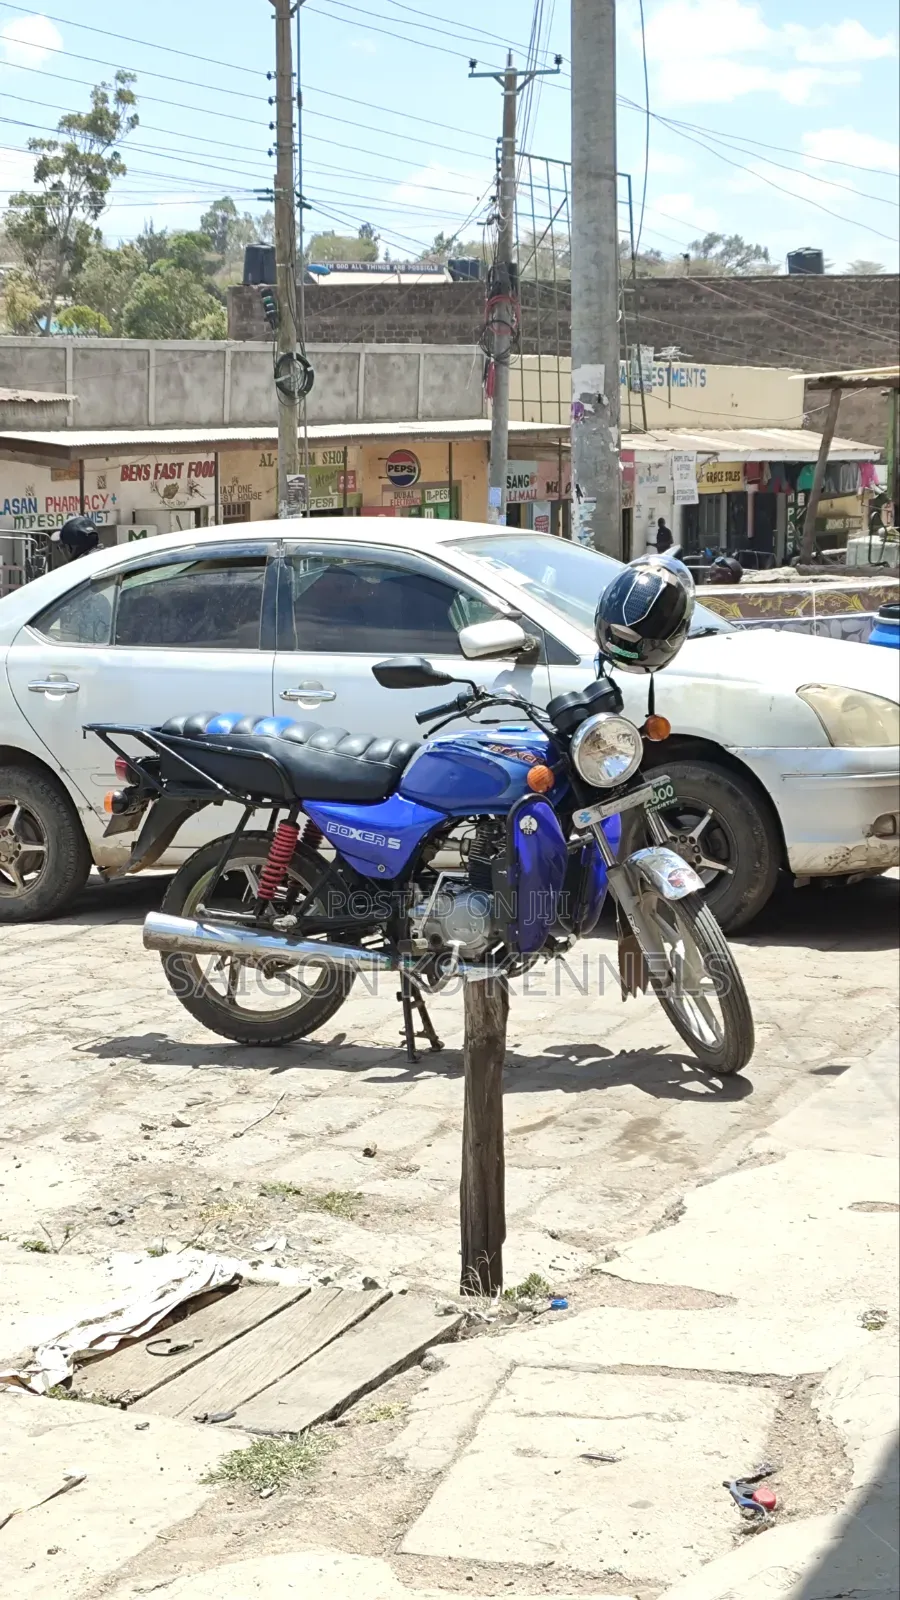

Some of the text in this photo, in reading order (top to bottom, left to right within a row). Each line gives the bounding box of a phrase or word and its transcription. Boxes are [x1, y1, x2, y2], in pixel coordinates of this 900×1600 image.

[366, 263, 391, 271] THINGS
[153, 462, 184, 480] FAST
[187, 460, 216, 478] FOOD
[387, 464, 416, 473] PEPSI
[237, 491, 262, 501] HOUSE
[0, 497, 38, 516] ASAN
[326, 821, 402, 850] BOXER S
